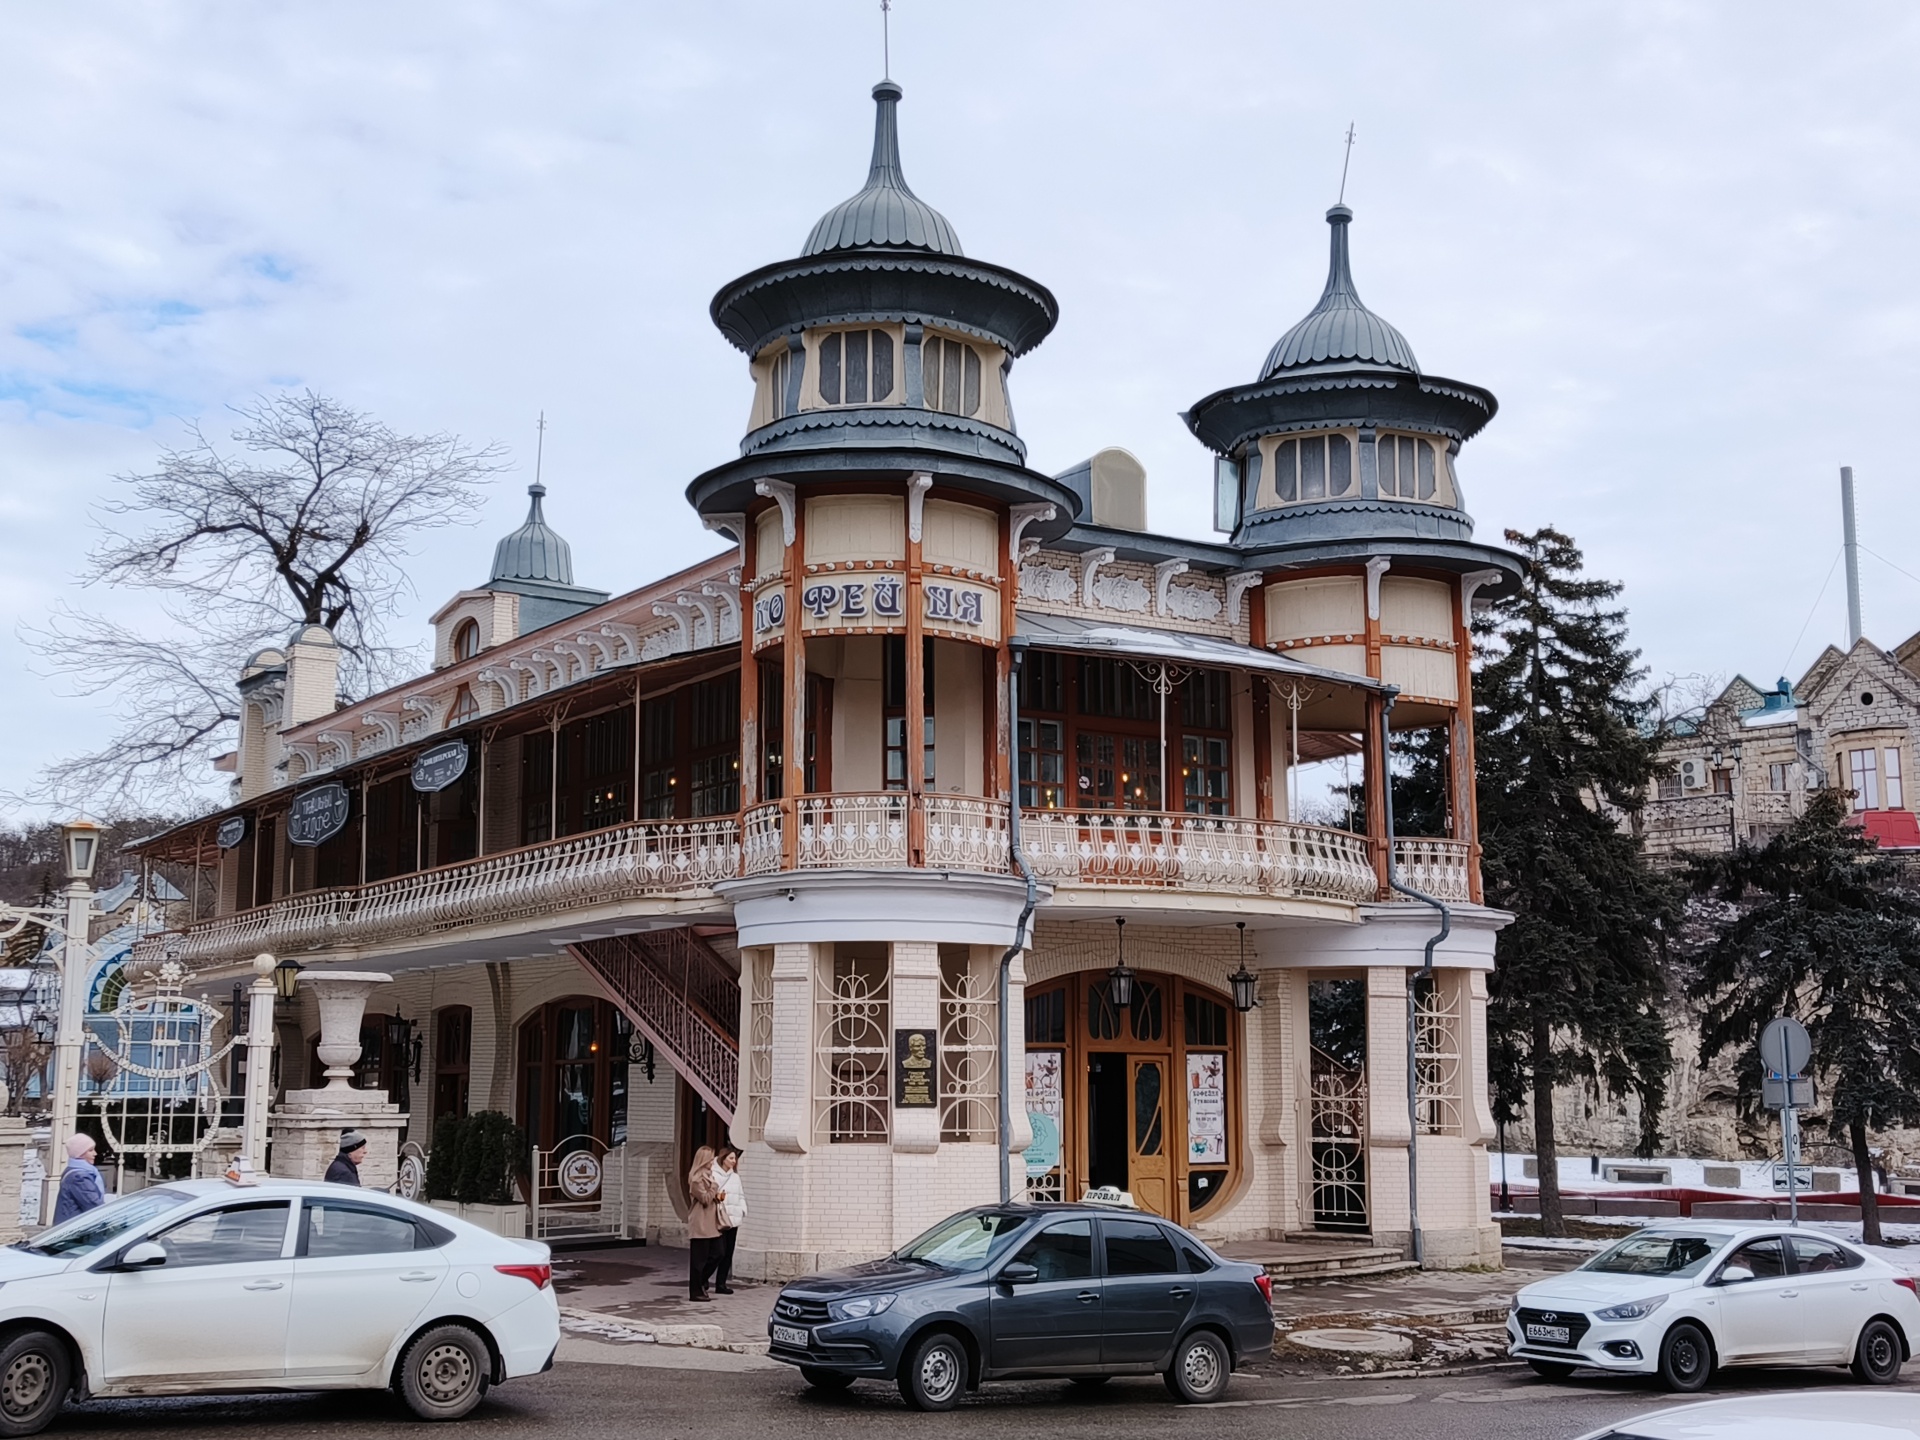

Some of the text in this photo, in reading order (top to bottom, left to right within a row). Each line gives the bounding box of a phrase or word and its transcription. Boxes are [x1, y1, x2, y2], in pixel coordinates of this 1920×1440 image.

[754, 575, 984, 634] КОФЕЙНЯ
[1086, 1192, 1121, 1202] ПРОВАЛ
[1529, 1327, 1556, 1337] Е663МЕ
